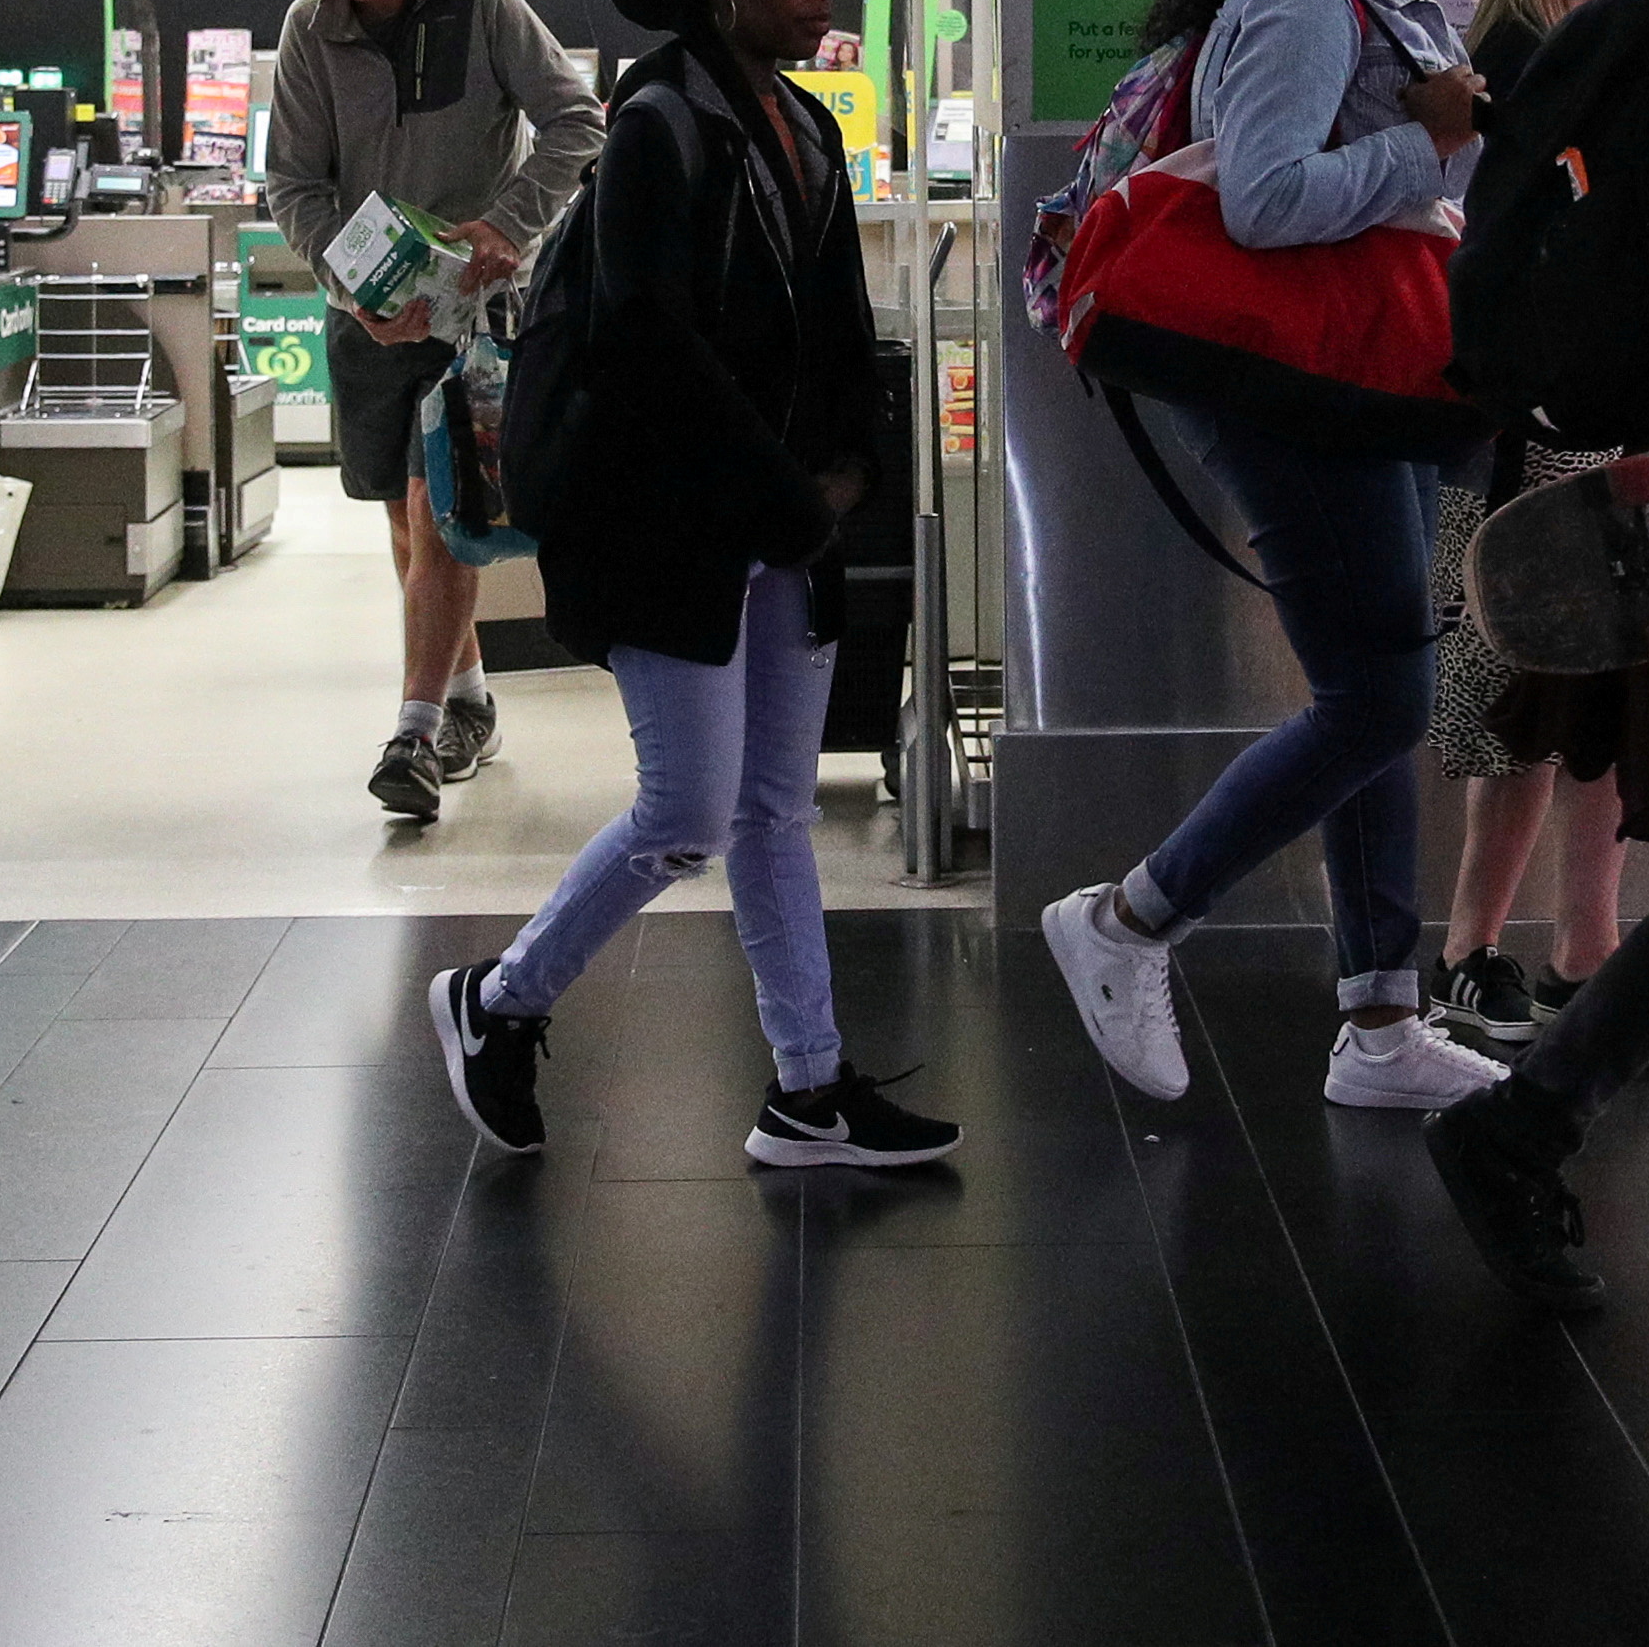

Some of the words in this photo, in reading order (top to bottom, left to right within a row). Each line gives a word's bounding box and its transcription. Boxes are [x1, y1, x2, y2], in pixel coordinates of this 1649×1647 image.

[1069, 21, 1098, 36] Put
[1102, 25, 1114, 35] a
[1069, 44, 1092, 59] for
[1096, 48, 1132, 63] your
[242, 316, 285, 332] Card
[286, 316, 324, 335] only
